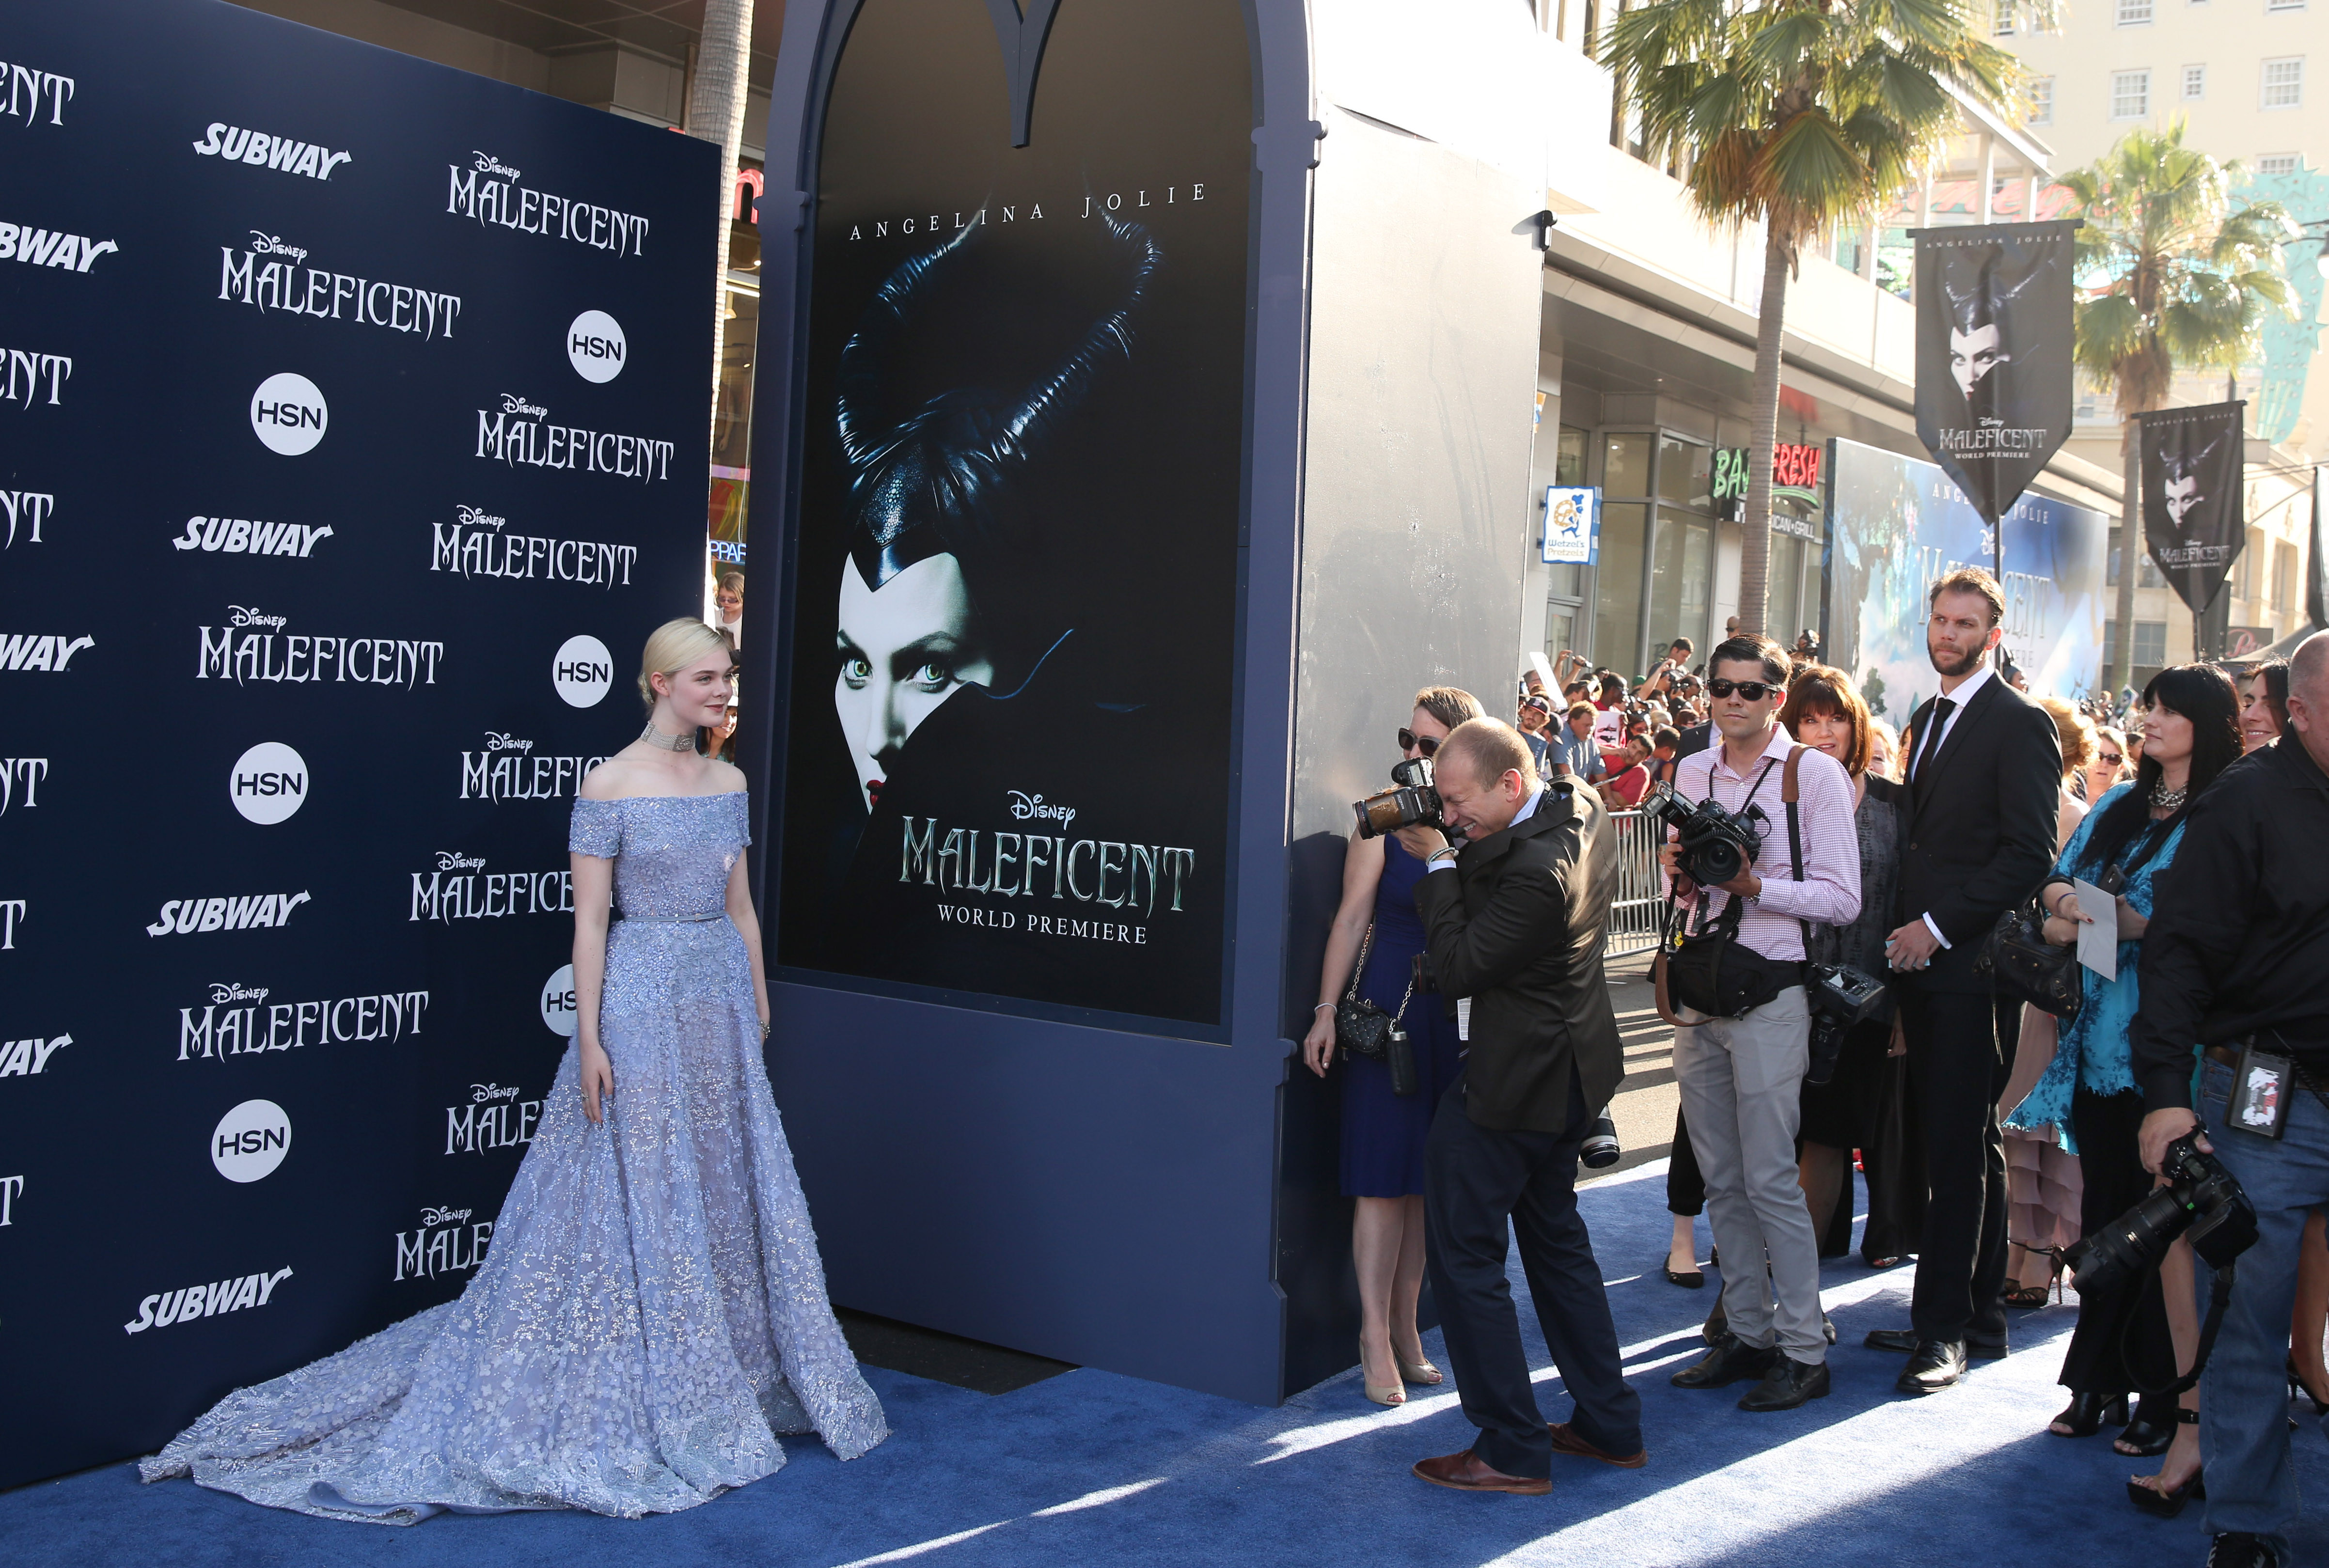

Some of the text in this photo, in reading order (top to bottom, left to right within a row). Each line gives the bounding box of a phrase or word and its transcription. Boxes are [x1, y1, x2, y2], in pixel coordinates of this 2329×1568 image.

[193, 123, 352, 180] SUBWAY
[473, 151, 520, 184] Disney
[447, 164, 649, 258] MALEFICENT
[850, 183, 1204, 241] ANGELINA JOLIE
[250, 230, 307, 265] Disney
[1925, 235, 2062, 249] ANGELINA JOLIE
[218, 246, 461, 342] MALEFICENT
[572, 333, 622, 361] HSN
[257, 400, 321, 430] HSN
[501, 393, 547, 422] Disney
[475, 409, 674, 485] MALEFICENT
[1939, 428, 2047, 451] MALEFICENT
[456, 505, 505, 532] Disney
[2013, 503, 2049, 524] JOLIE
[173, 516, 334, 557] SUBWAY
[1548, 539, 1585, 548] Wetzel's
[1794, 520, 1814, 539] GRILL
[430, 522, 637, 590] MALEFICENT
[1546, 548, 1585, 557] Pretzels
[228, 605, 286, 633] Disney
[196, 626, 443, 691] MALEFICENT
[558, 661, 608, 683] HSN
[485, 732, 533, 755] Disney
[237, 772, 302, 796] HSN
[1007, 790, 1076, 831] Disney
[436, 851, 486, 873] Disney
[899, 815, 1195, 919] MALEFICENT
[409, 871, 575, 925] MALEFICE
[146, 890, 311, 938] SUBWAY
[937, 904, 1147, 944] WORLD PREMIERE
[209, 983, 268, 1004] Disney
[547, 989, 577, 1013] HS
[177, 991, 429, 1063] MALEFICENT
[471, 1083, 519, 1102] Disney
[219, 1127, 284, 1158] HSN
[445, 1099, 548, 1156] MALE
[421, 1206, 472, 1226] Disney
[394, 1222, 493, 1281] MALE
[124, 1265, 293, 1335] SUBWAY
